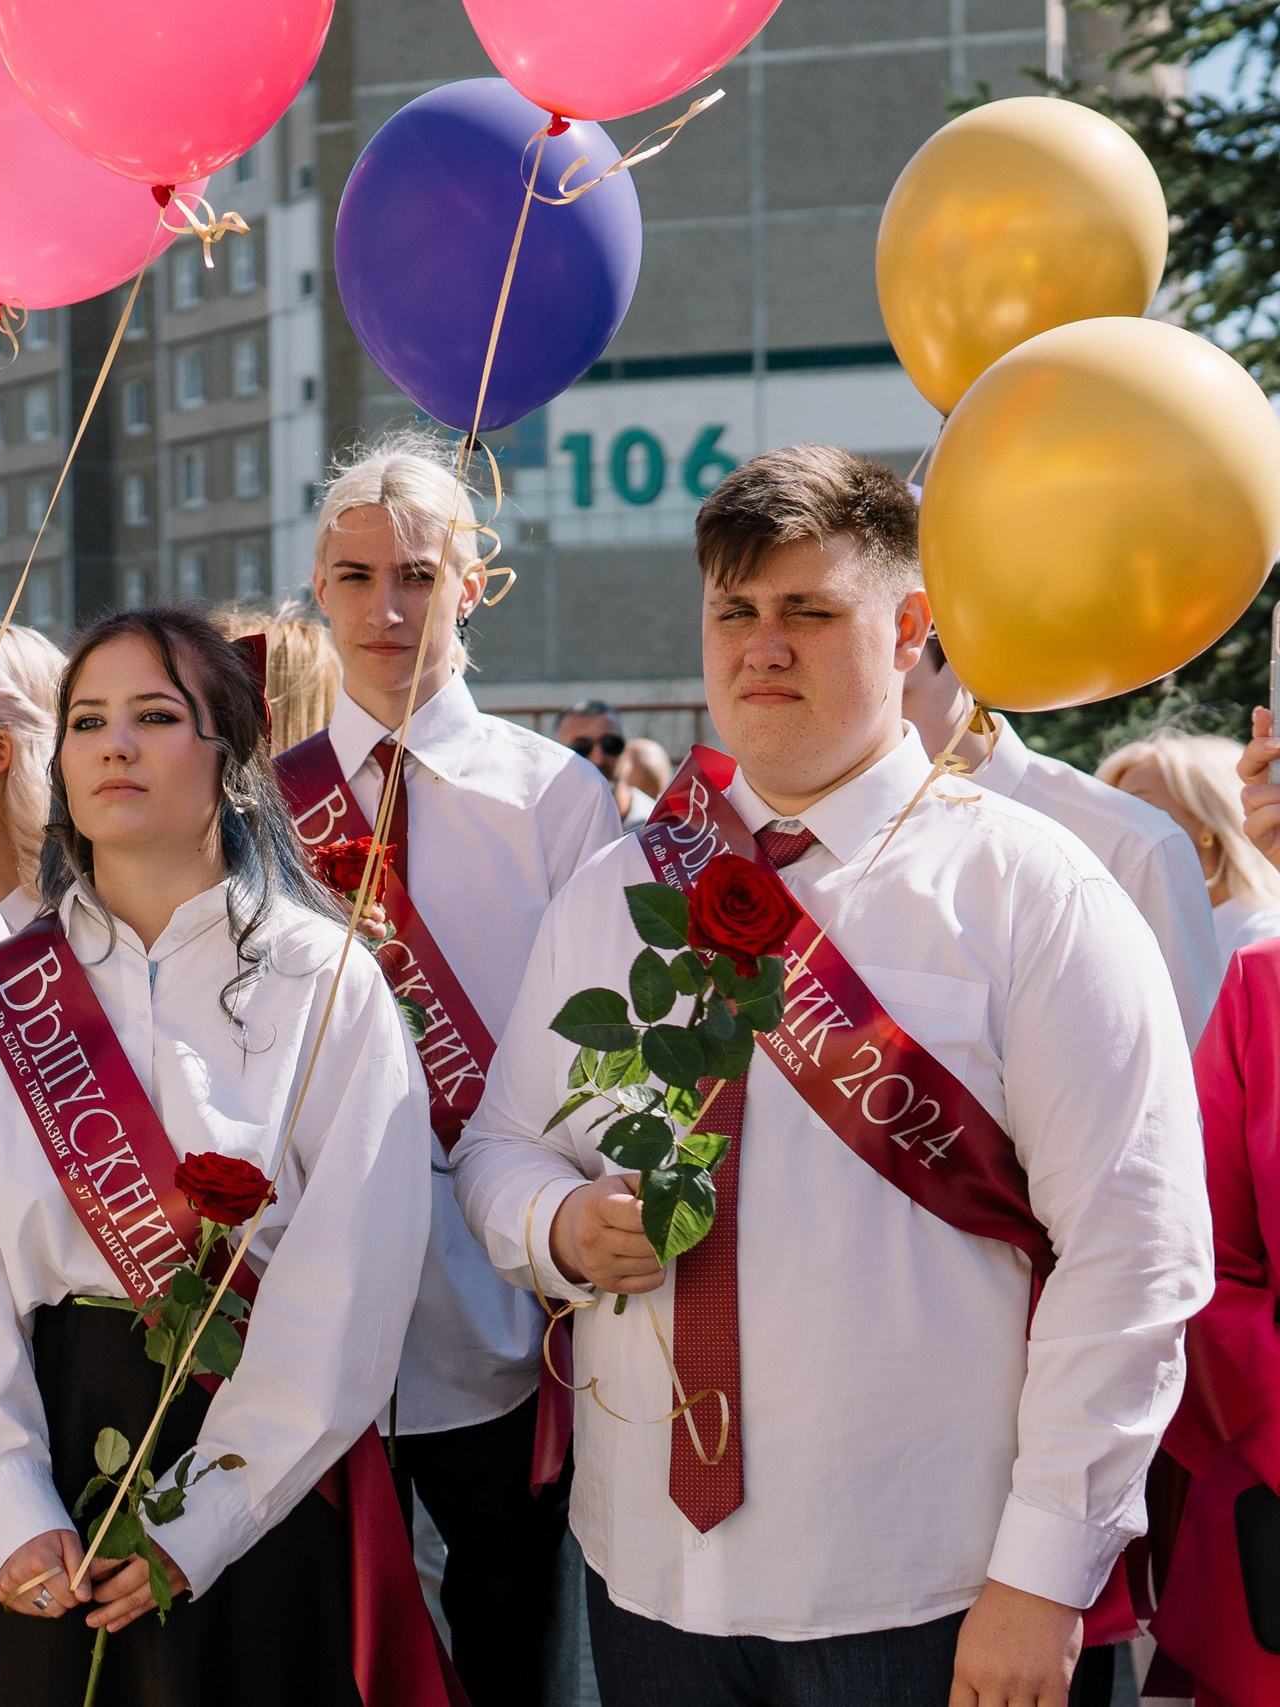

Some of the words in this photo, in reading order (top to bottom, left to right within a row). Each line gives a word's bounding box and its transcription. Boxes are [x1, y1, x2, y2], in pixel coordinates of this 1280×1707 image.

[560, 424, 739, 507] 106
[1, 1031, 31, 1077] КЛАСС
[25, 1077, 71, 1160] ГИМНАЗИЯ
[64, 1161, 80, 1181] №
[75, 1182, 92, 1201] 37
[86, 1203, 98, 1222] Г.
[96, 1222, 147, 1296] МИНСКА
[831, 1040, 965, 1170] 2024
